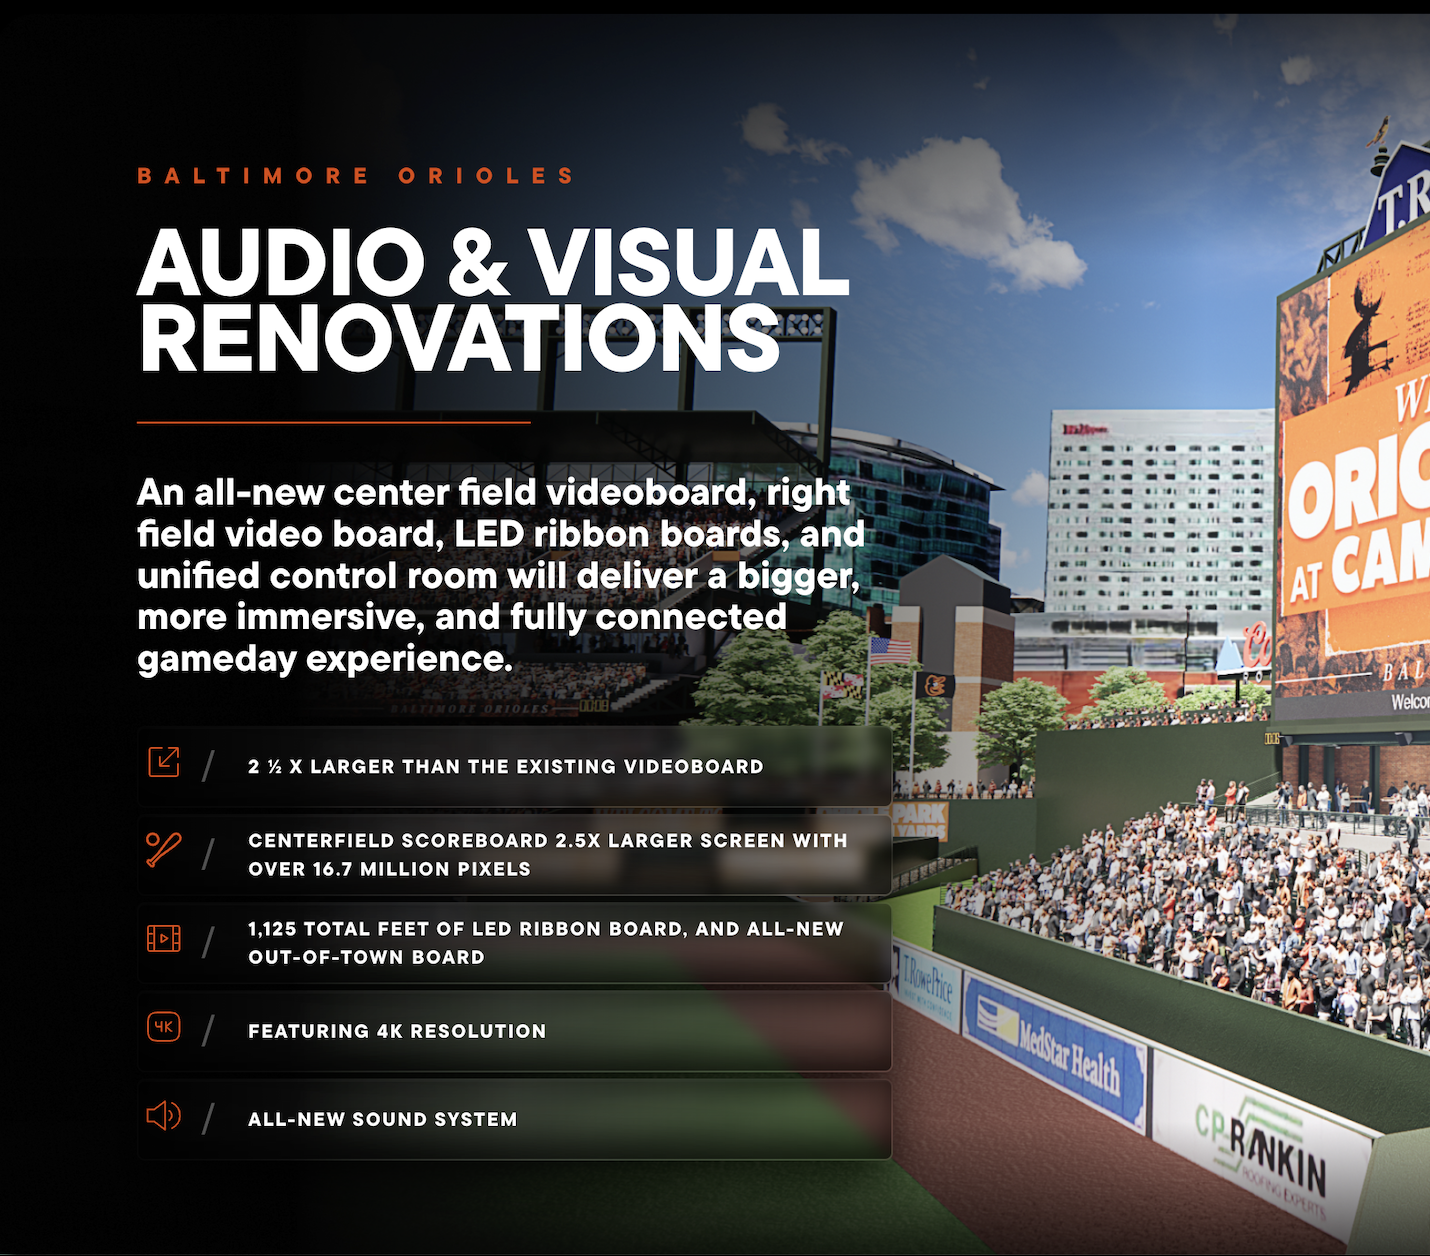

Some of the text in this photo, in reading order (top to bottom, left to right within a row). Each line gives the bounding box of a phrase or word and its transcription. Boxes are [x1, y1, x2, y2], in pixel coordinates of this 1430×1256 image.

[1289, 561, 1323, 603] AT
[390, 704, 549, 714] BALTIMORE ORIOLES
[893, 803, 946, 823] PARK
[897, 825, 946, 840] YARDS
[1020, 1019, 1121, 1098] MedStar Health
[1230, 1117, 1327, 1198] RANKIN
[1241, 1165, 1327, 1223] ROOFING EXPERTS
